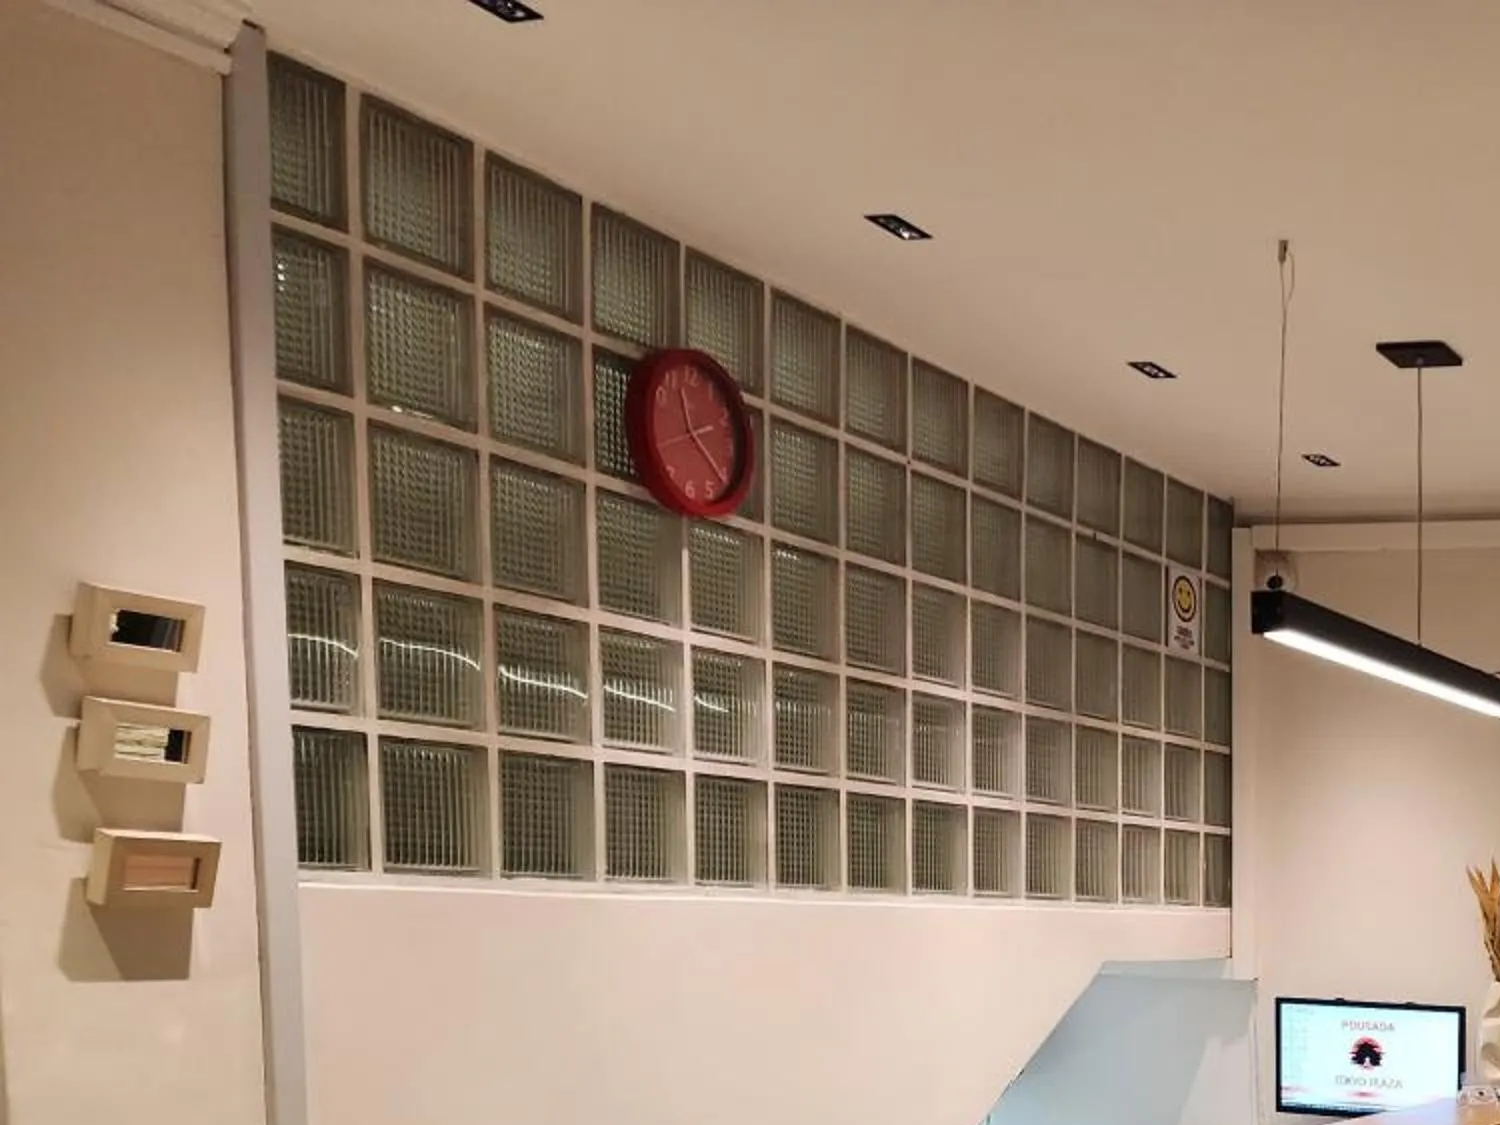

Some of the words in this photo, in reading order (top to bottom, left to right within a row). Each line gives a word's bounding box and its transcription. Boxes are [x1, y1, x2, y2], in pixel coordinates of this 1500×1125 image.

[685, 366, 699, 387] 12
[685, 480, 695, 499] 6
[703, 480, 715, 499] 5
